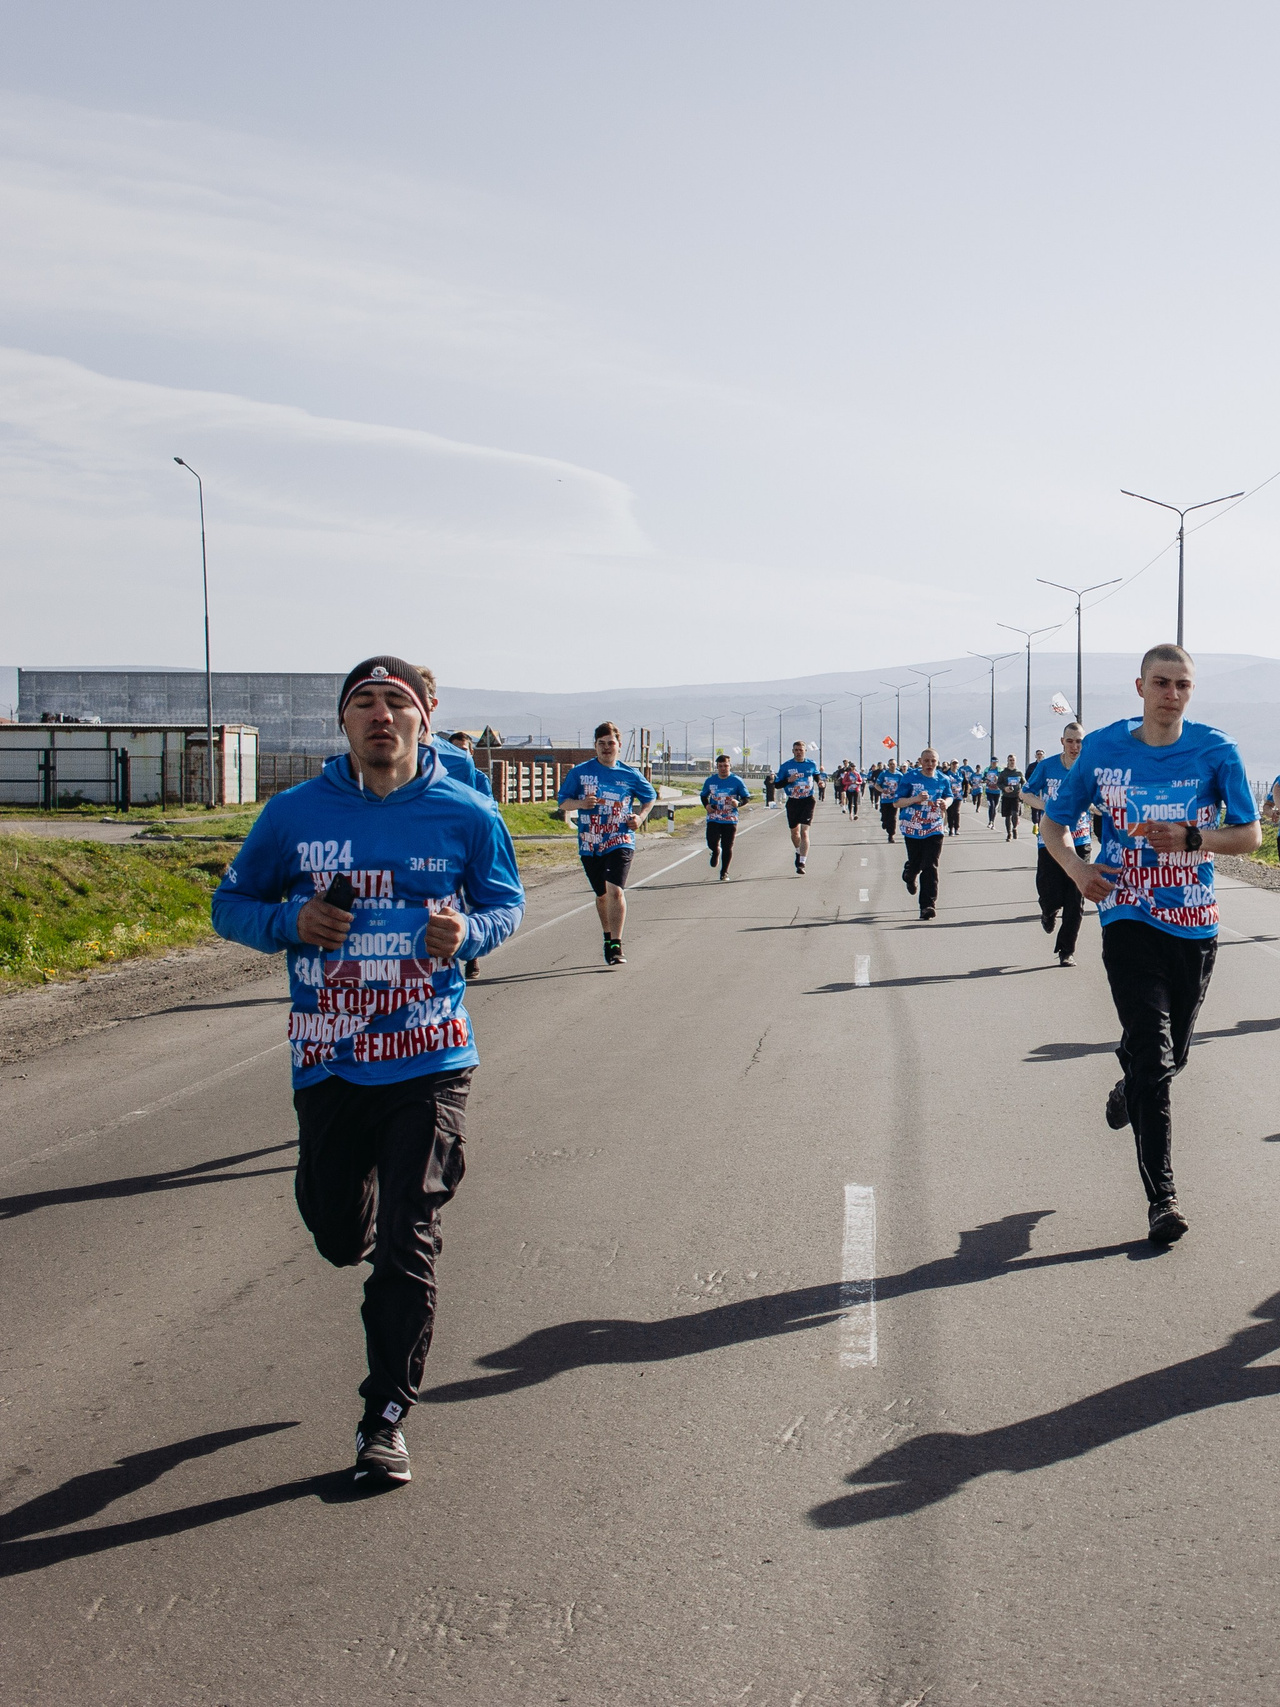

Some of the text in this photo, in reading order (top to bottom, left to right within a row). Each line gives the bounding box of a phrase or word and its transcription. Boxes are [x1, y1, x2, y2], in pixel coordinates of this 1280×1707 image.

[1142, 803, 1186, 820] 20055
[297, 840, 354, 872] 2024
[311, 870, 395, 899] #ЧТА
[349, 932, 412, 957] 30025
[316, 984, 436, 1017] #ГОРДО
